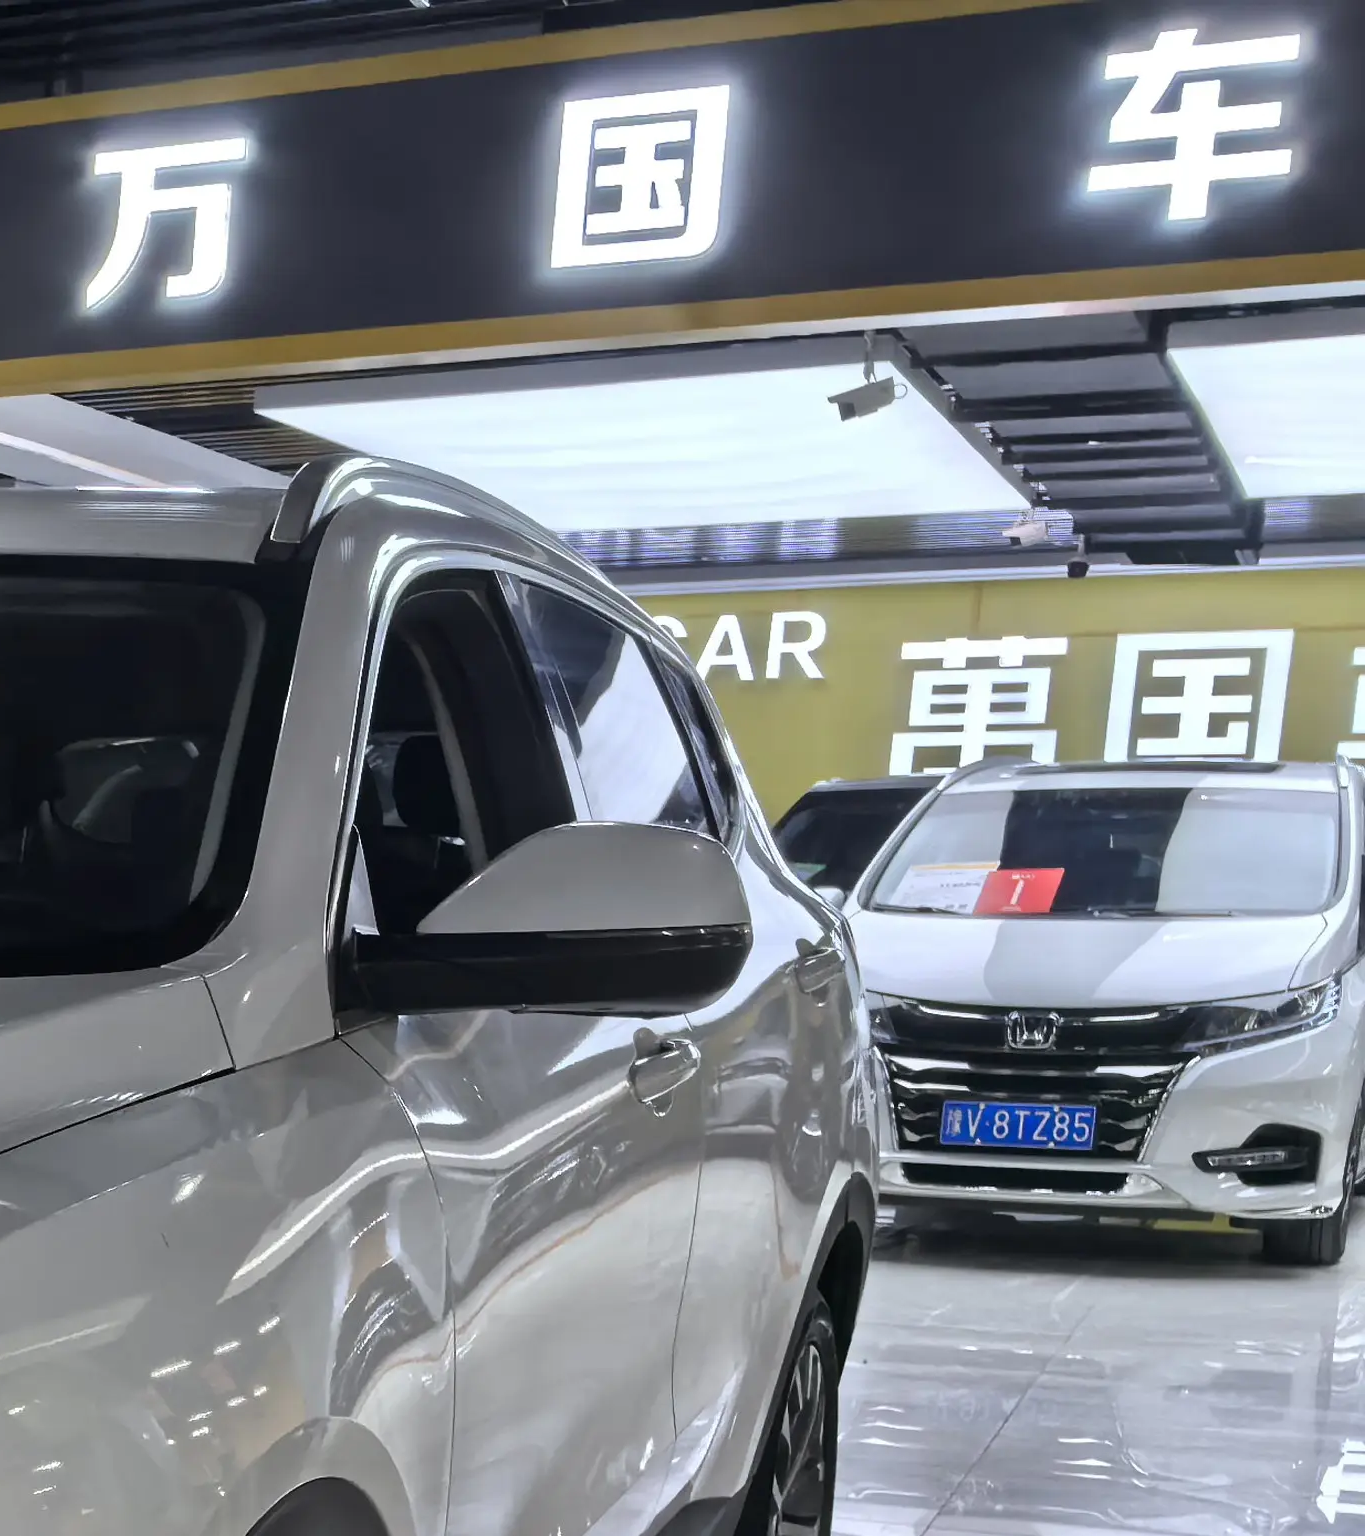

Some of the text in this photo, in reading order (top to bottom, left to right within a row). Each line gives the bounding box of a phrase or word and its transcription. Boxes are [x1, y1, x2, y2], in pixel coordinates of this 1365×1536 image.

[86, 28, 1300, 311] 万国车
[889, 629, 1365, 776] 萬国
